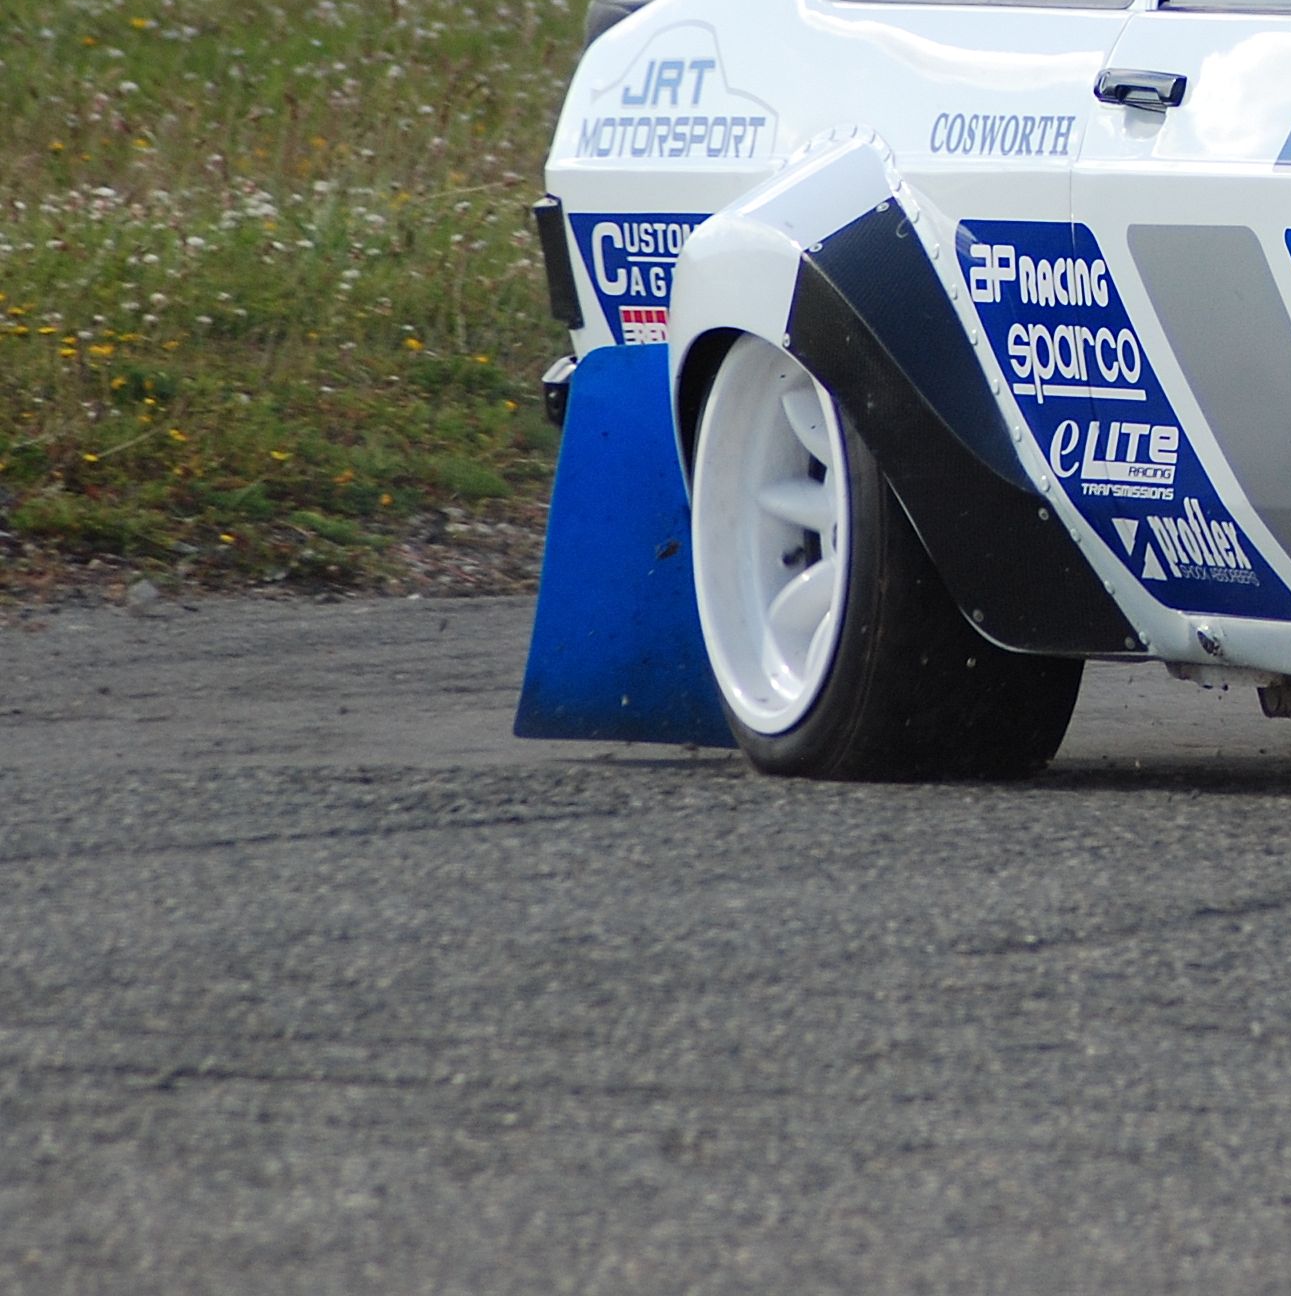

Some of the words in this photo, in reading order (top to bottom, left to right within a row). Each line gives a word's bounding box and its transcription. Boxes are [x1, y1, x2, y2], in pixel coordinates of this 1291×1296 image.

[621, 59, 717, 108] JRT
[575, 116, 767, 159] MOTORSPORT
[930, 112, 1077, 157] COSWORTH
[1018, 255, 1109, 307] RACING
[1007, 322, 1144, 404] sparco
[1128, 465, 1172, 480] RACING
[1146, 496, 1253, 579] proflex
